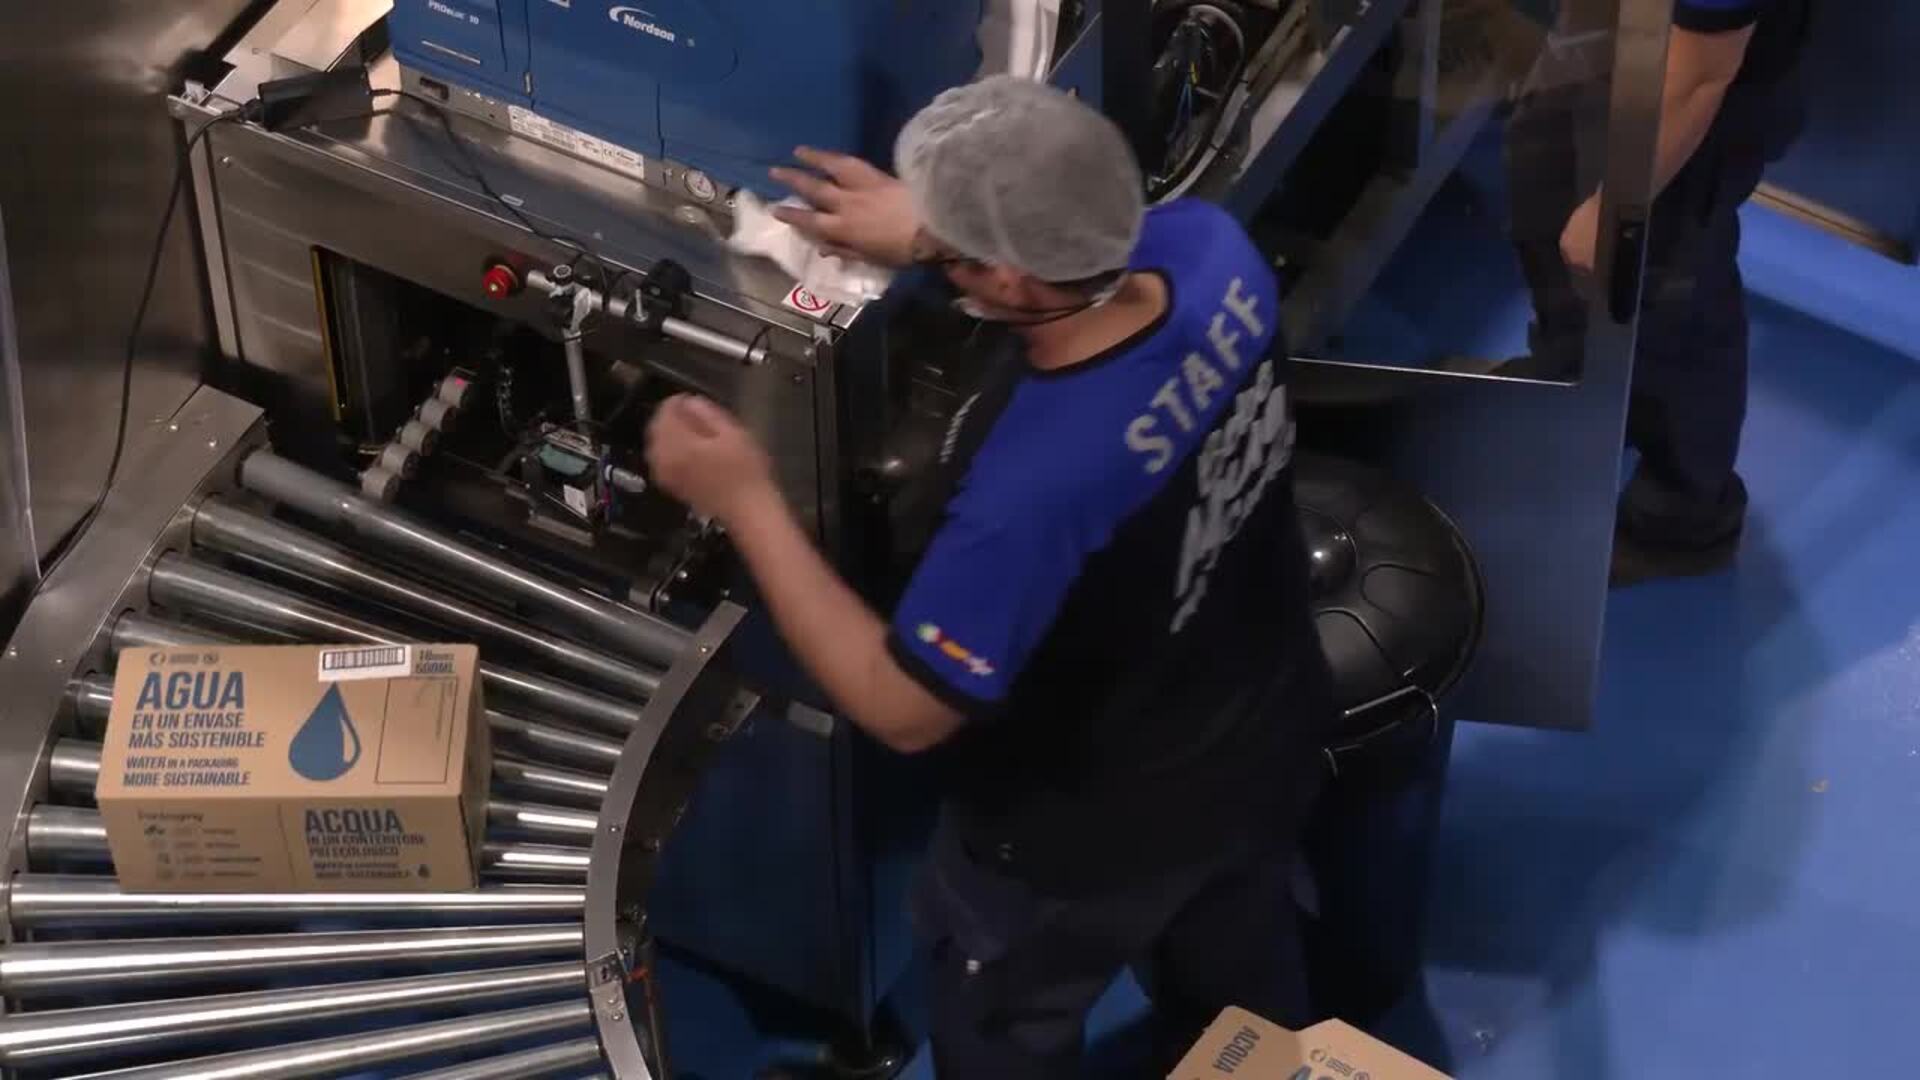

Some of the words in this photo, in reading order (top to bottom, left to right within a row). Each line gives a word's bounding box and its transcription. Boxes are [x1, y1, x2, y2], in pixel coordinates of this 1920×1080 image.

[623, 13, 675, 42] Nordson
[1125, 277, 1263, 474] STAFF
[136, 671, 245, 710] AGUA
[131, 713, 153, 729] EN
[157, 713, 179, 729] UN
[183, 712, 244, 728] ENVASE
[168, 731, 265, 748] SOSTENIBLE
[126, 756, 165, 768] WATER
[123, 772, 159, 786] MORE
[163, 771, 250, 786] SUSTAINABLE
[305, 809, 405, 834] ACQUA
[1212, 1026, 1260, 1073] ACQUA
